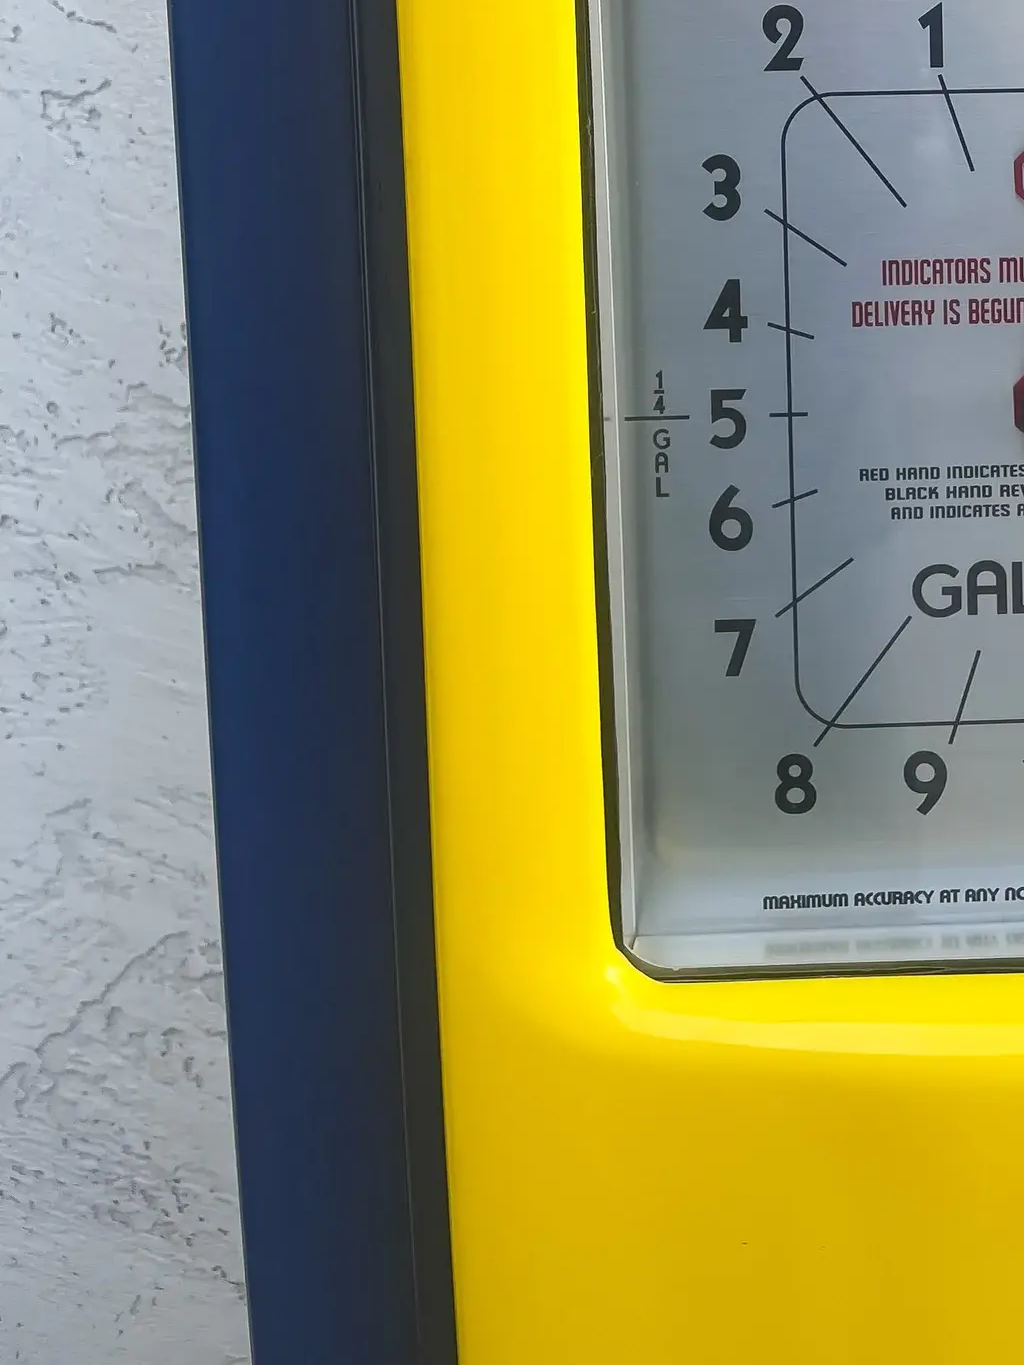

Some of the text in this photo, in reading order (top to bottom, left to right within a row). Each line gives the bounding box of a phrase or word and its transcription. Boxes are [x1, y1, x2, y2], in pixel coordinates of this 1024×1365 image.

[762, 4, 805, 72] 2
[917, 1, 944, 69] 1
[701, 153, 742, 222] 3
[881, 257, 991, 287] INDICATORS
[702, 278, 749, 343] 4
[851, 299, 935, 328] DELIVERY
[943, 298, 961, 325] IS
[709, 388, 747, 450] 5
[859, 467, 890, 482] RED
[895, 466, 941, 481] HAND
[884, 486, 939, 501] BLACK
[945, 484, 993, 499] HAND
[708, 484, 754, 552] 6
[890, 506, 924, 520] AND
[929, 503, 1011, 519] INDICATES
[714, 618, 757, 677] 7
[774, 753, 817, 815] 8
[903, 750, 948, 816] 9
[762, 893, 849, 910] MAXIMUM
[853, 889, 935, 907] ACCURACY
[939, 888, 961, 904] AT
[964, 887, 1000, 903] ANY
